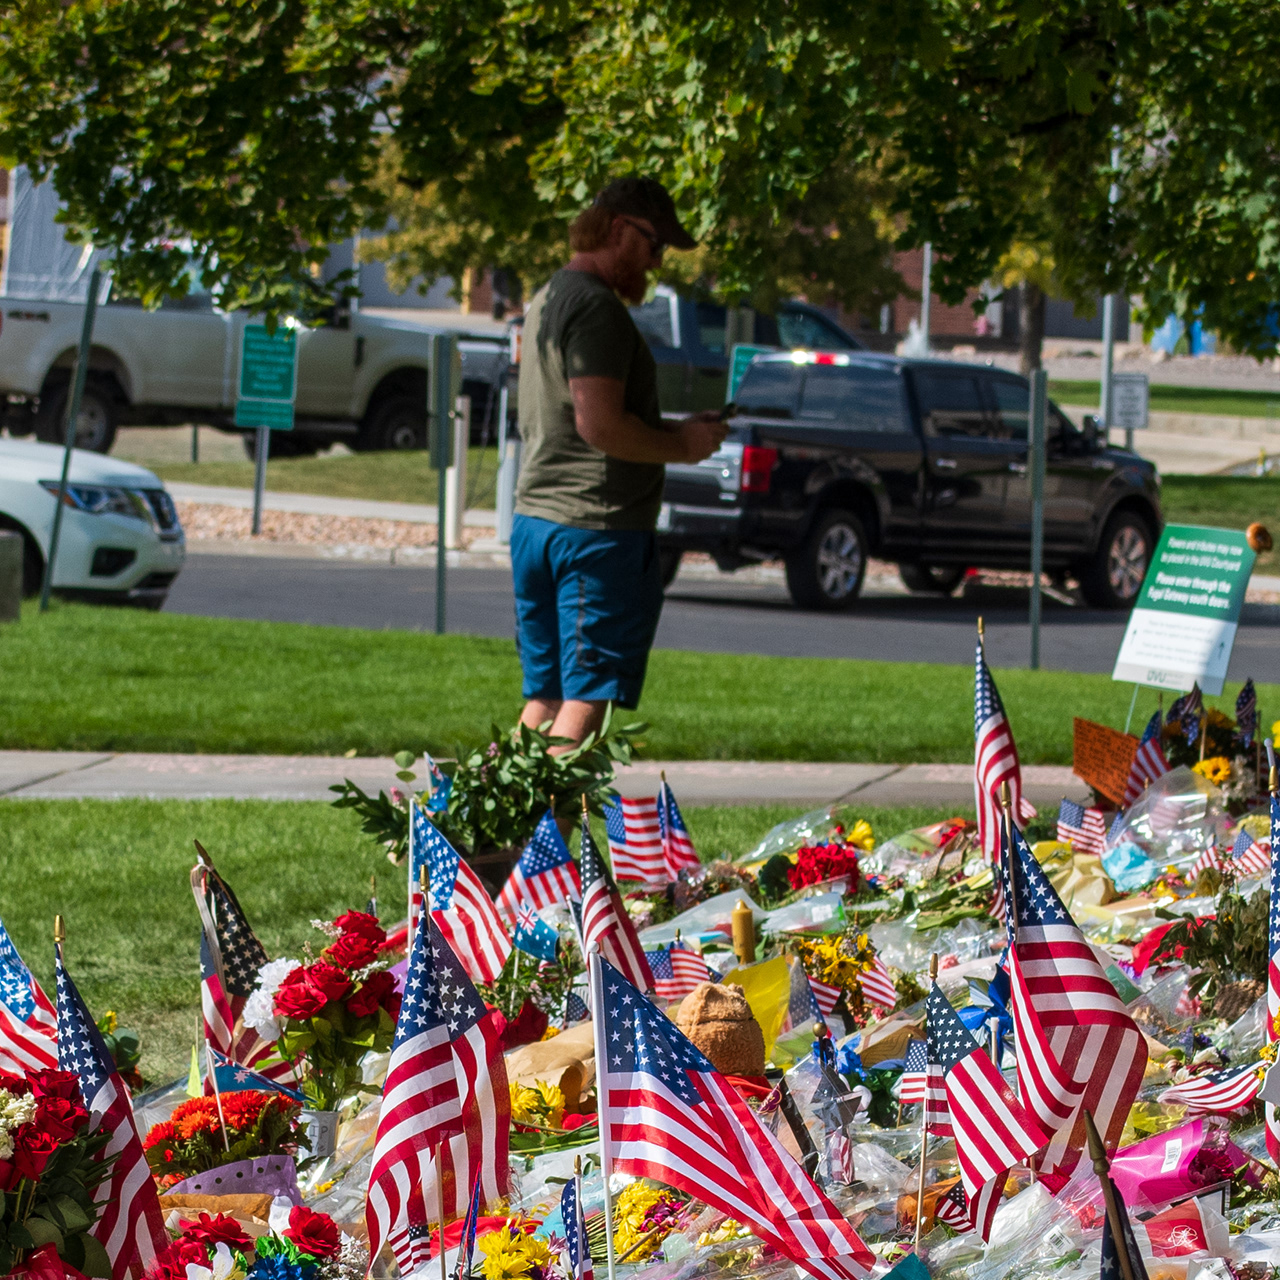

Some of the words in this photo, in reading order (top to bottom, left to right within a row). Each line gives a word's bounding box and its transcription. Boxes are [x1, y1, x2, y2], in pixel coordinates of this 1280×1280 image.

[1155, 571, 1176, 586] Please
[1175, 577, 1192, 588] enter
[1191, 577, 1218, 593] through
[1217, 580, 1231, 593] the
